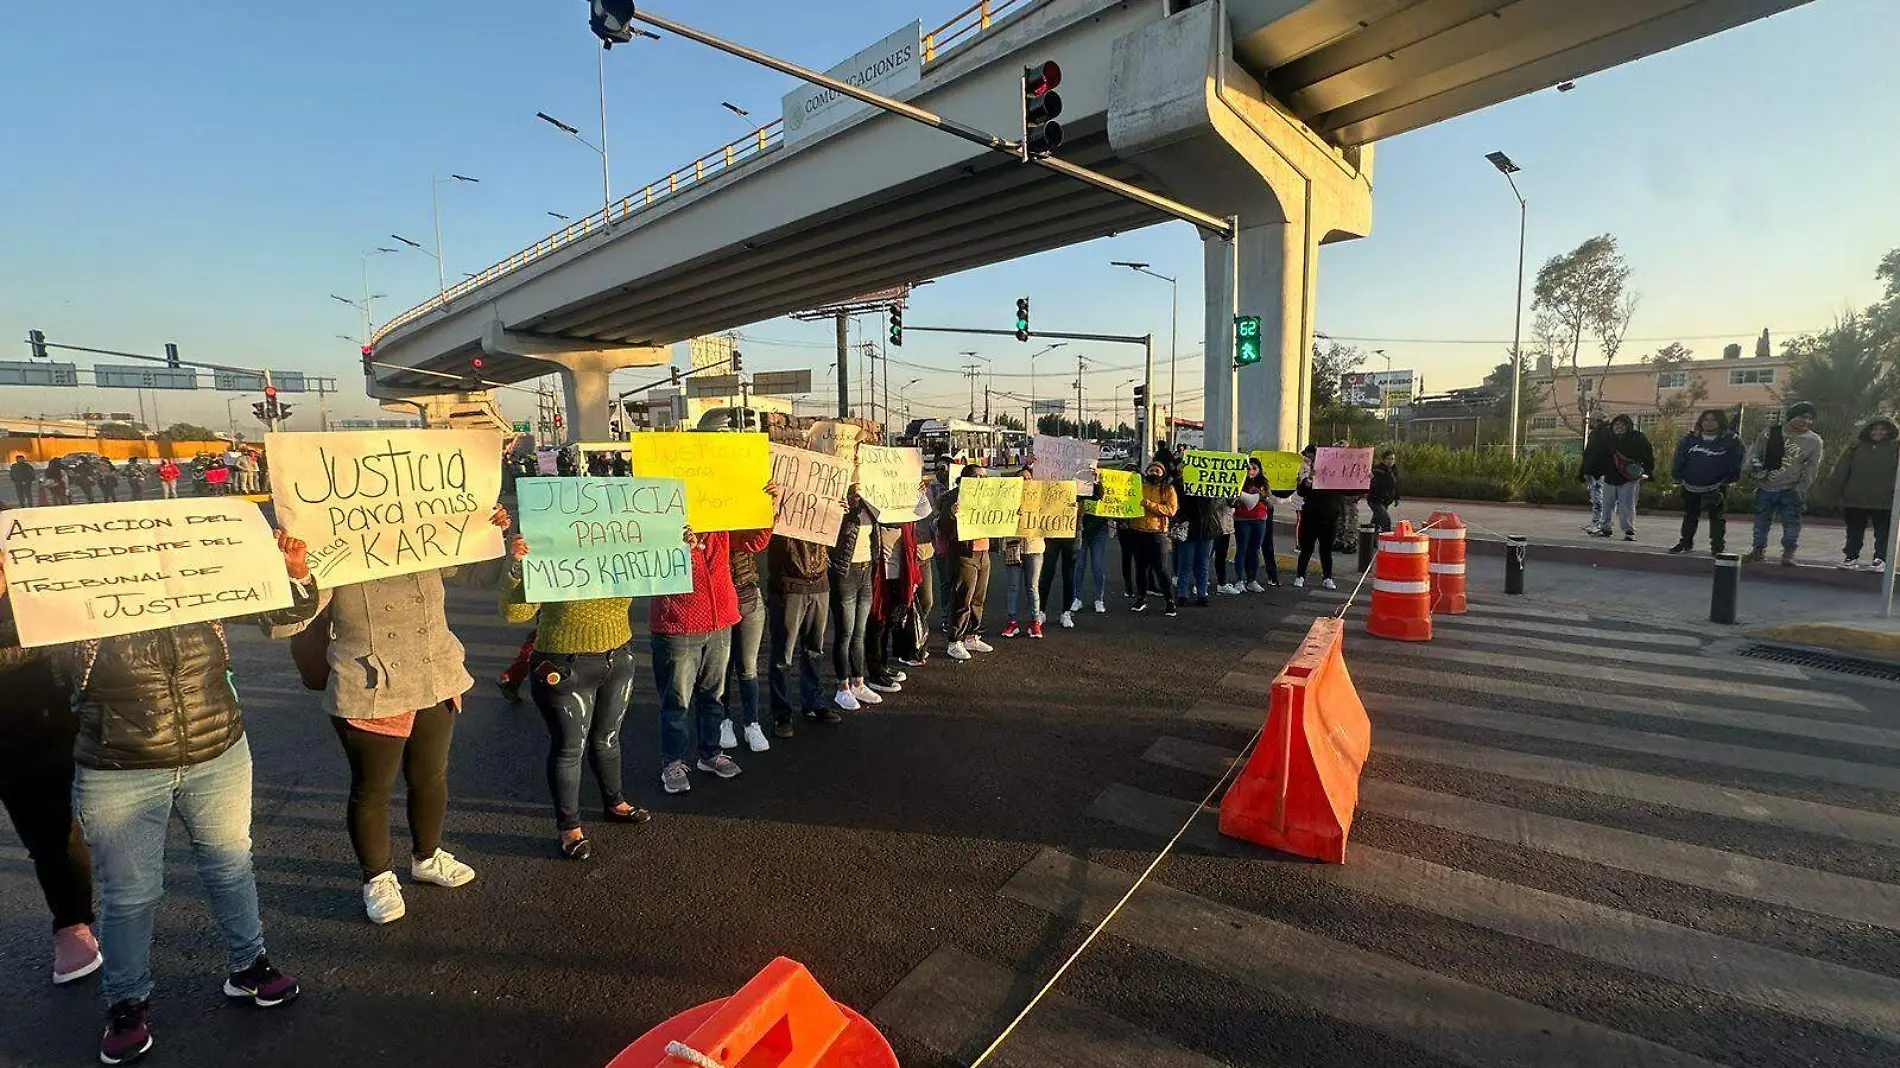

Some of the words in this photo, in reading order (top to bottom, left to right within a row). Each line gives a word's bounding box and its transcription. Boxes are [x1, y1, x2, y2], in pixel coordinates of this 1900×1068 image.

[804, 45, 912, 113] COMUICACIONES
[1240, 321, 1256, 336] 62
[771, 453, 801, 488] ICIA
[804, 460, 849, 498] PARA
[1183, 454, 1250, 471] JUSTICIA
[1198, 470, 1238, 484] PARA
[528, 481, 686, 515] JUSTICIA
[778, 488, 836, 535] KARI
[6, 518, 172, 540] ATENCION
[186, 515, 242, 524] DEL
[569, 520, 643, 548] PARA
[8, 540, 192, 565] PRESIDENTE
[199, 537, 243, 547] DEL
[361, 515, 470, 569] KARY
[11, 572, 171, 593] TRIBUNAL
[179, 565, 223, 577] DE
[526, 558, 591, 590] MISS
[597, 548, 688, 585] KARINA
